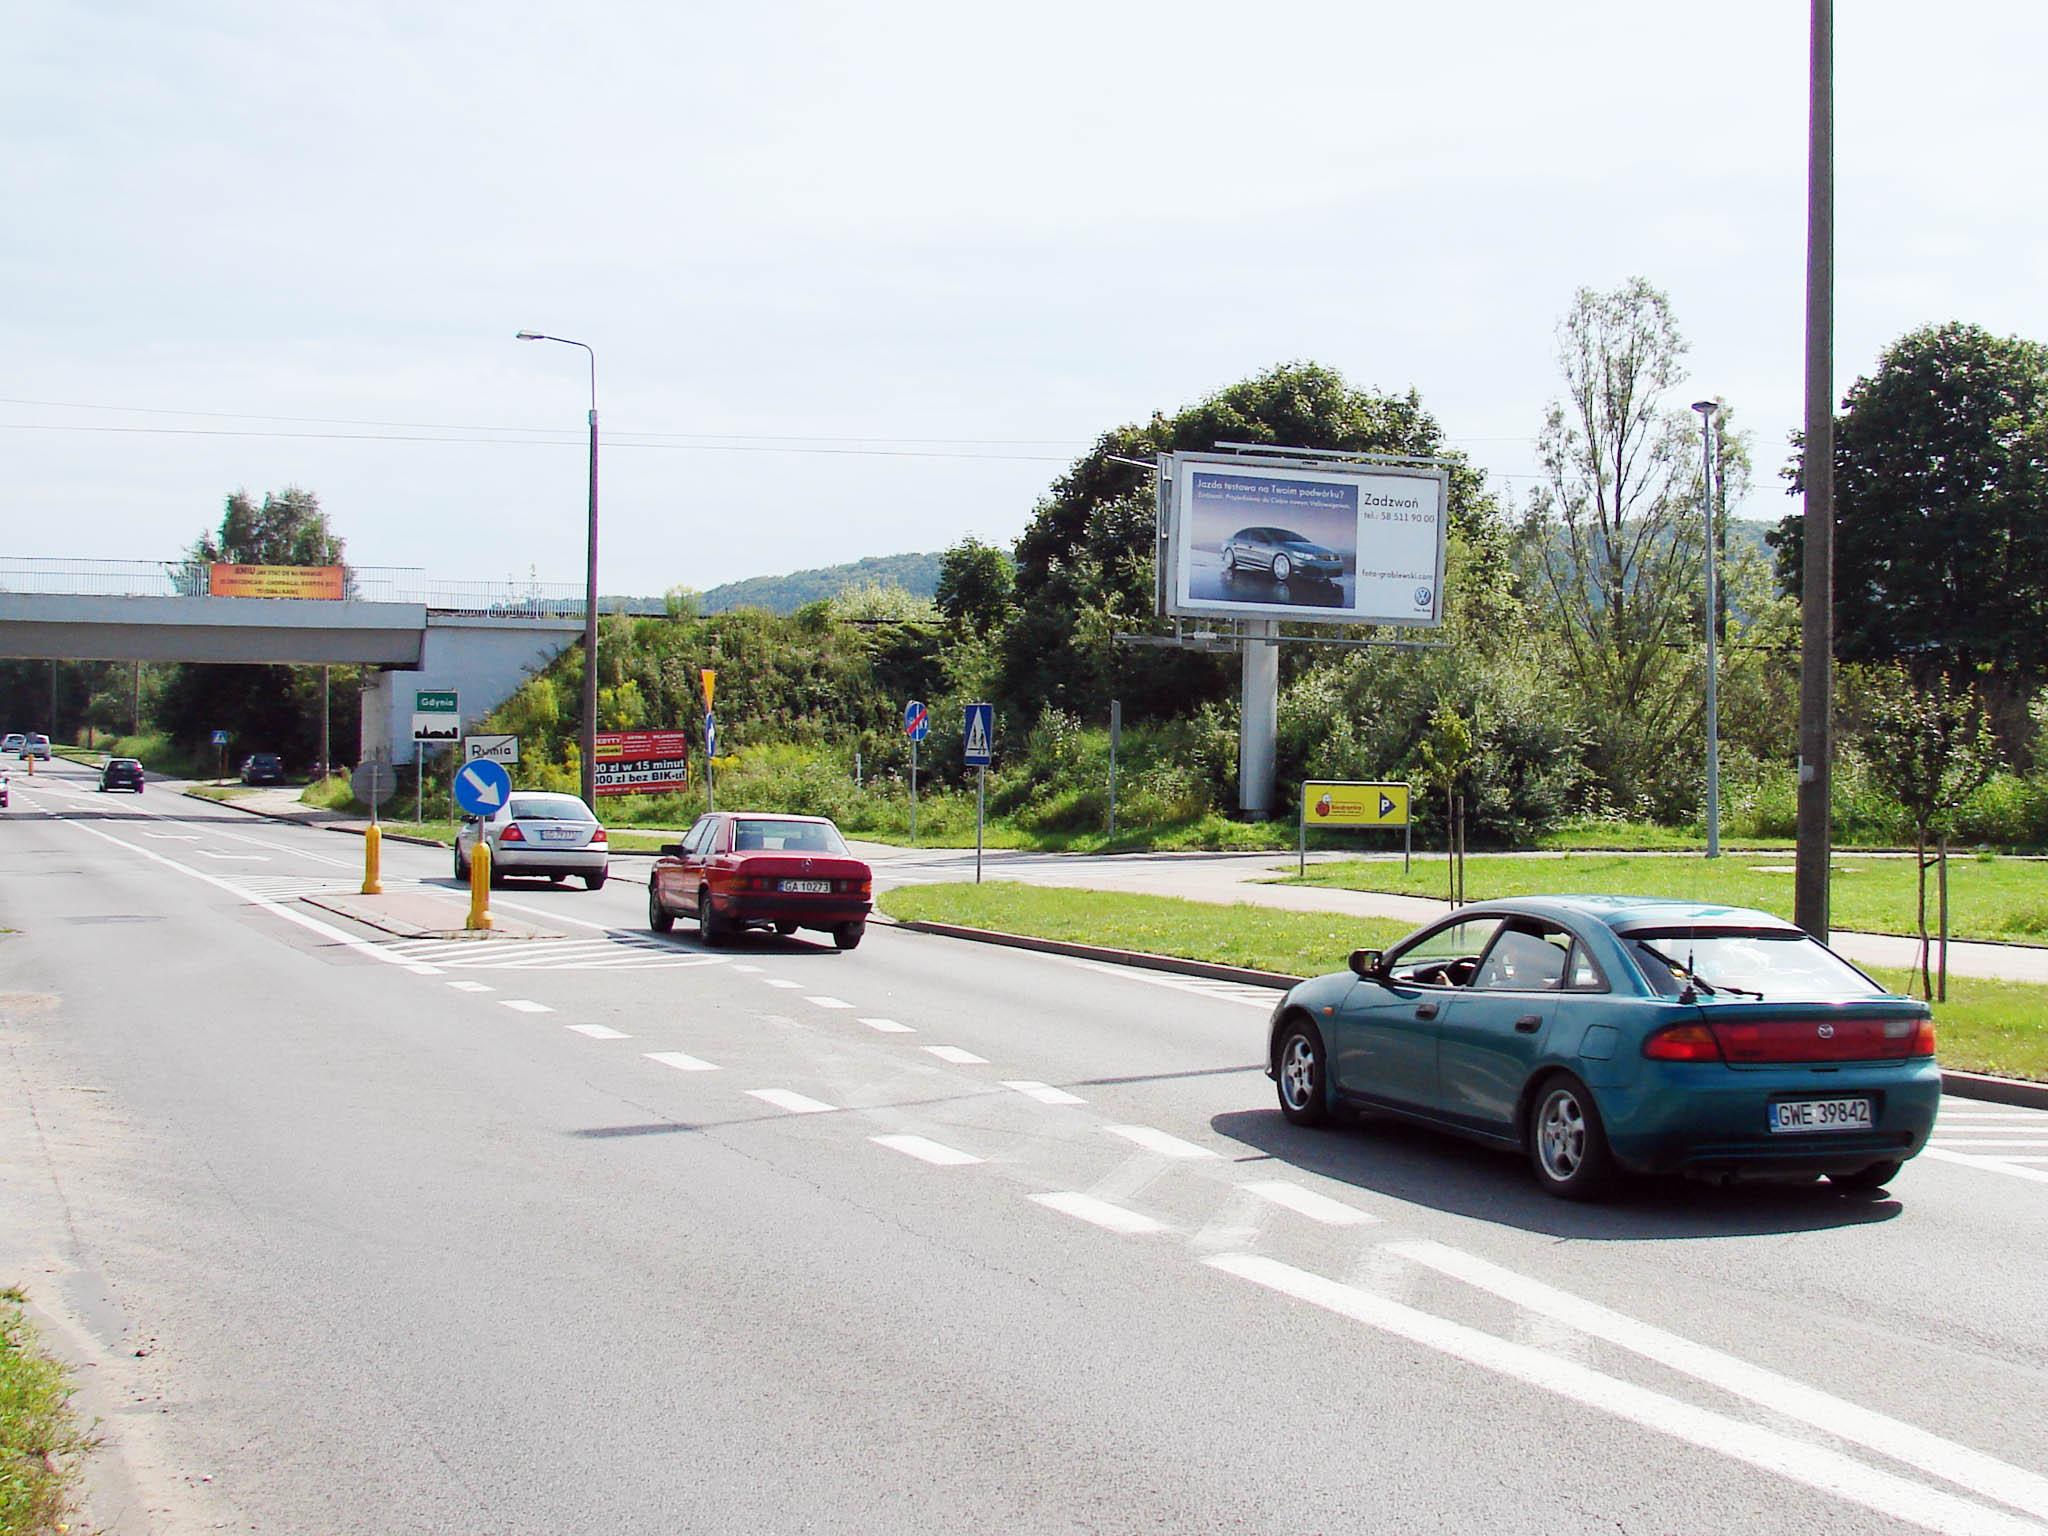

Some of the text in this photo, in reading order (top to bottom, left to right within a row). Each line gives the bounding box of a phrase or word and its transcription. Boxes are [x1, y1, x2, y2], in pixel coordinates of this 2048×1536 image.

[1197, 479, 1223, 490] Jazda
[1224, 481, 1256, 492] testowa
[1271, 484, 1297, 495] Twoim
[1364, 493, 1419, 508] Zadzwoń
[1380, 512, 1391, 520] 58
[1394, 513, 1408, 521] 511
[1411, 514, 1422, 522] 90
[1423, 515, 1435, 523] 00
[421, 698, 454, 708] Gdynia
[471, 744, 512, 756] Rumia
[622, 763, 633, 771] w
[636, 760, 650, 770] 15
[652, 759, 685, 769] minut
[629, 773, 648, 782] bez
[651, 770, 686, 780] BIK-u!
[1381, 799, 1390, 811] P
[785, 881, 829, 892] GA 10273
[1779, 1101, 1868, 1126] GWE 39842
